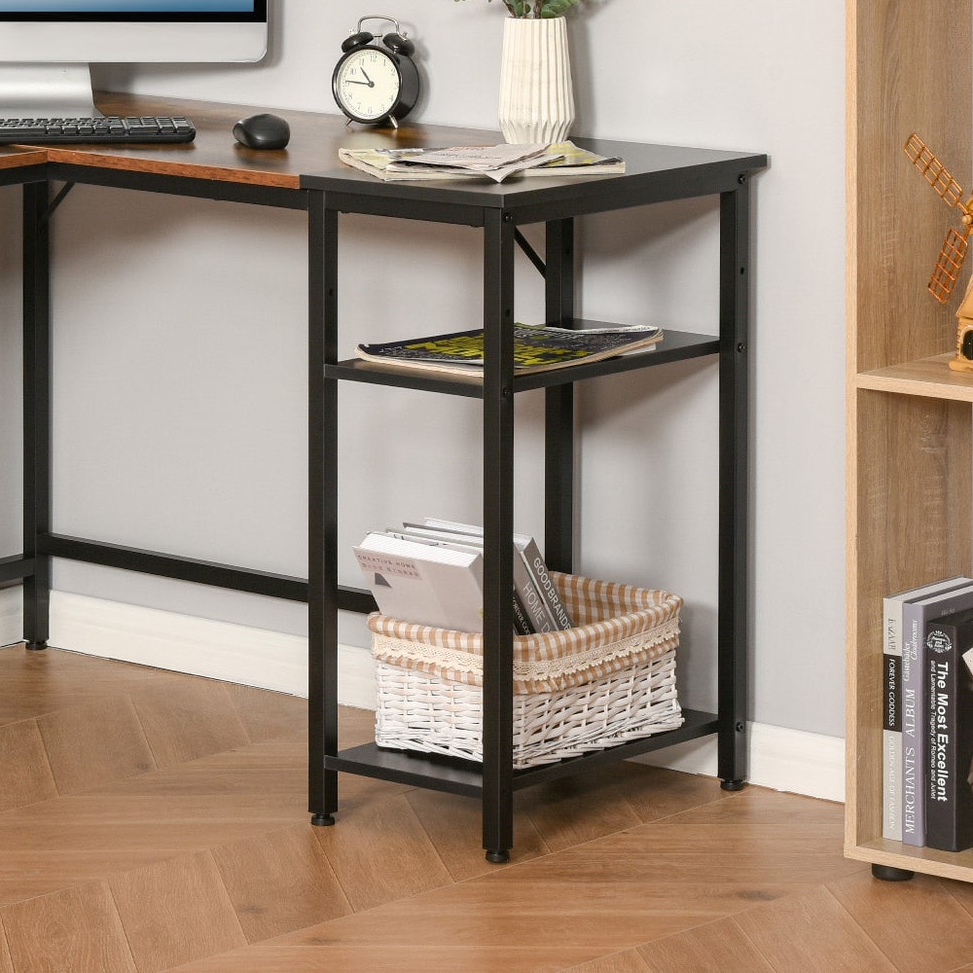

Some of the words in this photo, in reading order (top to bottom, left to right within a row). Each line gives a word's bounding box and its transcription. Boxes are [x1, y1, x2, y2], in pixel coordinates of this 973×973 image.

[523, 582, 546, 625] HOME
[888, 658, 896, 690] FOREVER
[937, 661, 949, 689] The
[888, 691, 896, 727] GODDESS
[905, 689, 916, 738] ALBUM
[937, 692, 949, 730] Most
[937, 733, 949, 803] Excellent
[905, 747, 916, 835] MERCHANTS
